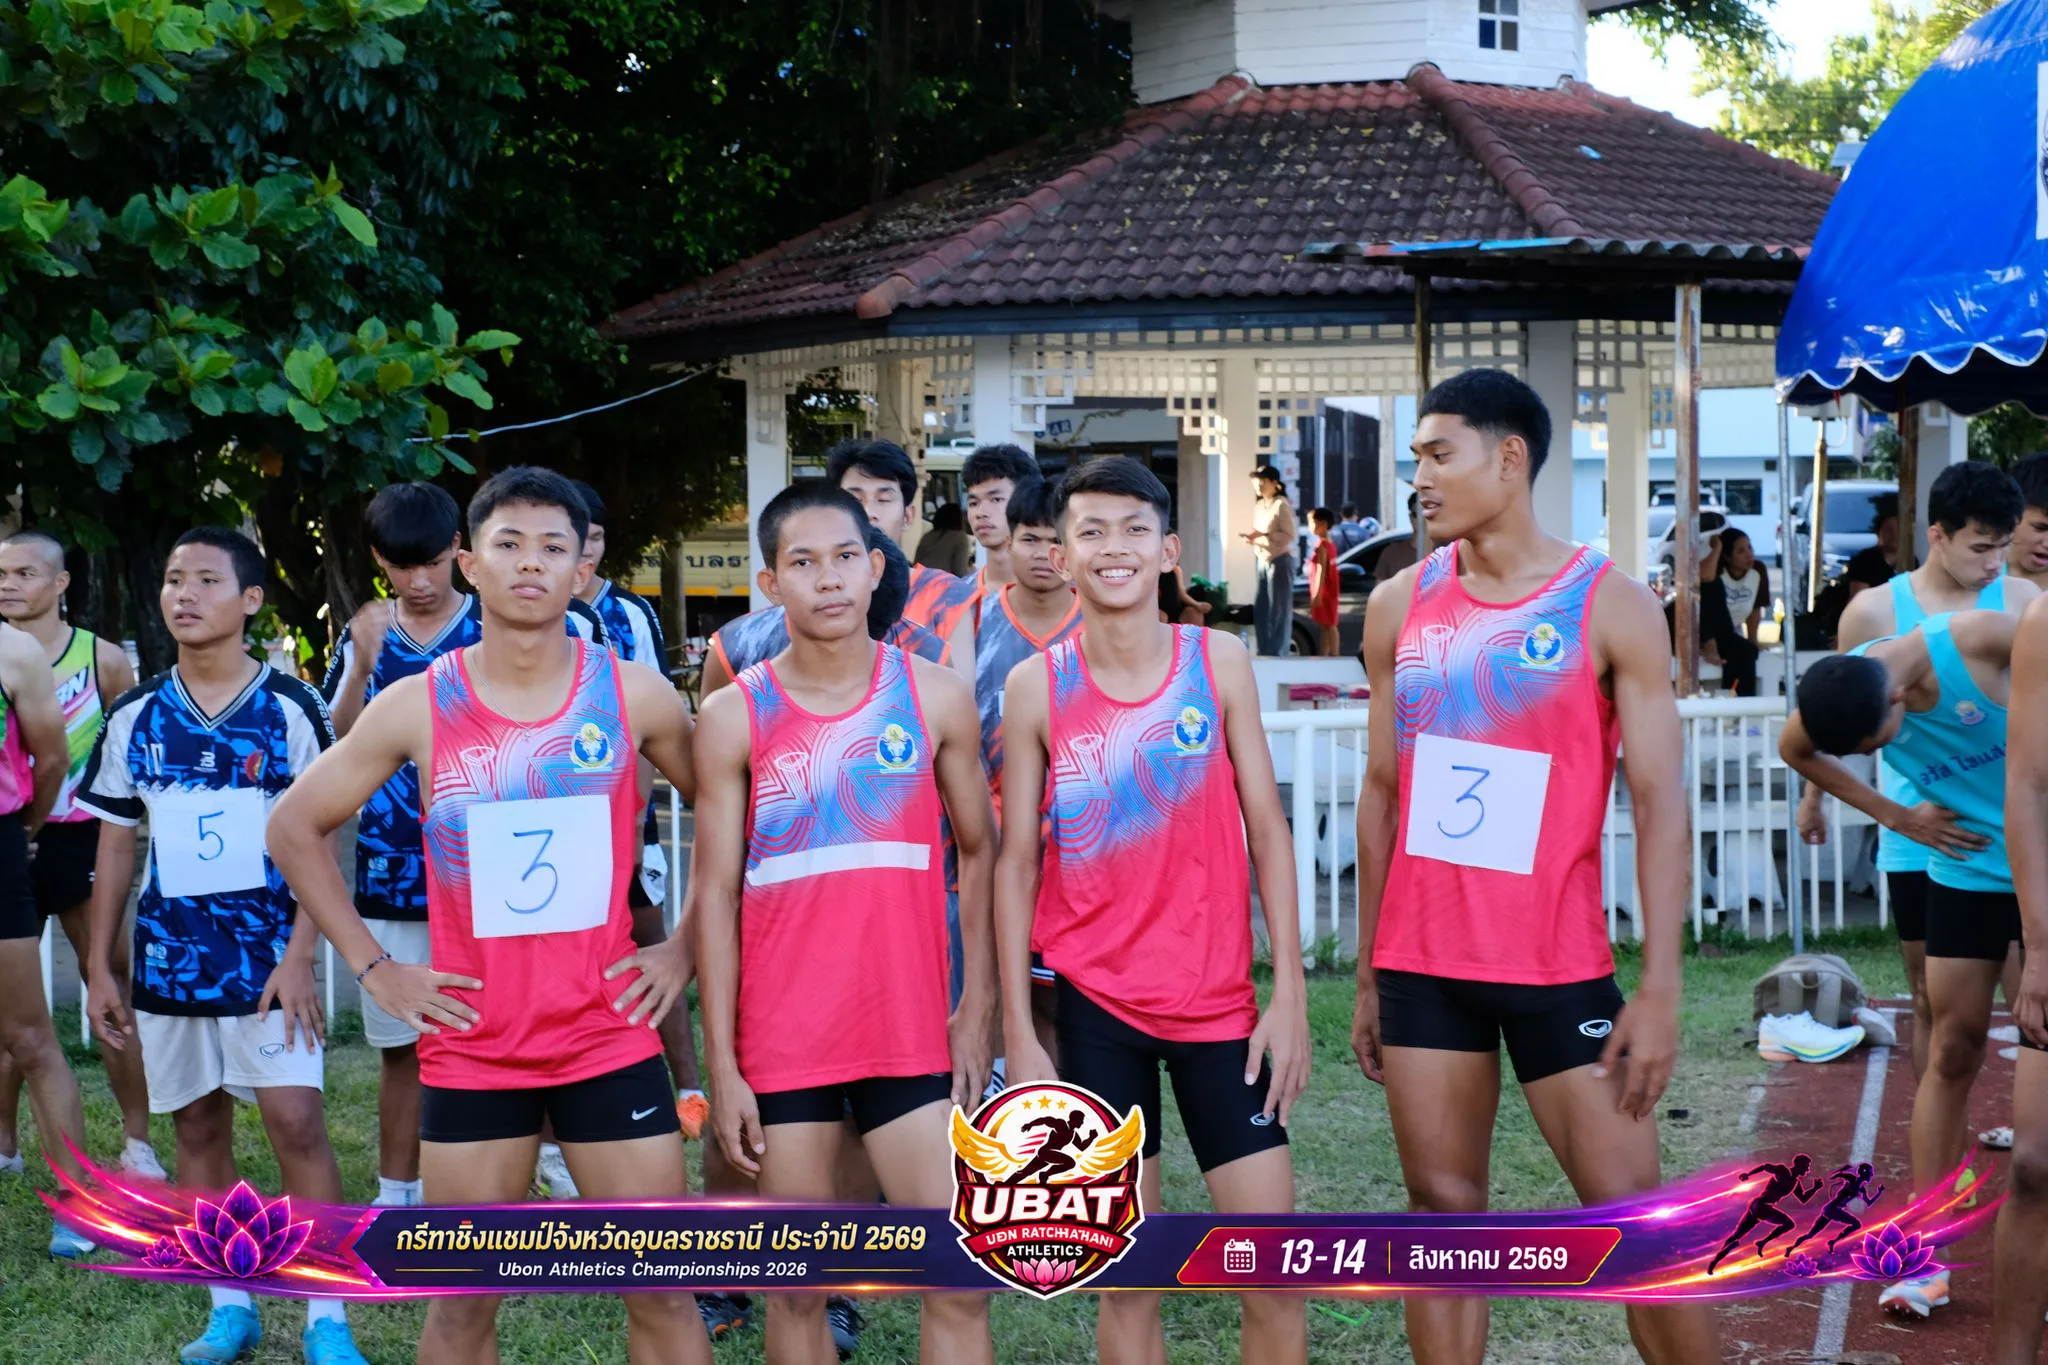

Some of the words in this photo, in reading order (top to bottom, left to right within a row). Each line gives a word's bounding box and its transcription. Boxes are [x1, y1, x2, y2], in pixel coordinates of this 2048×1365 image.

[323, 719, 337, 745] EDIT
[1437, 765, 1490, 839] 3
[197, 810, 225, 861] 5
[504, 829, 559, 915] 3
